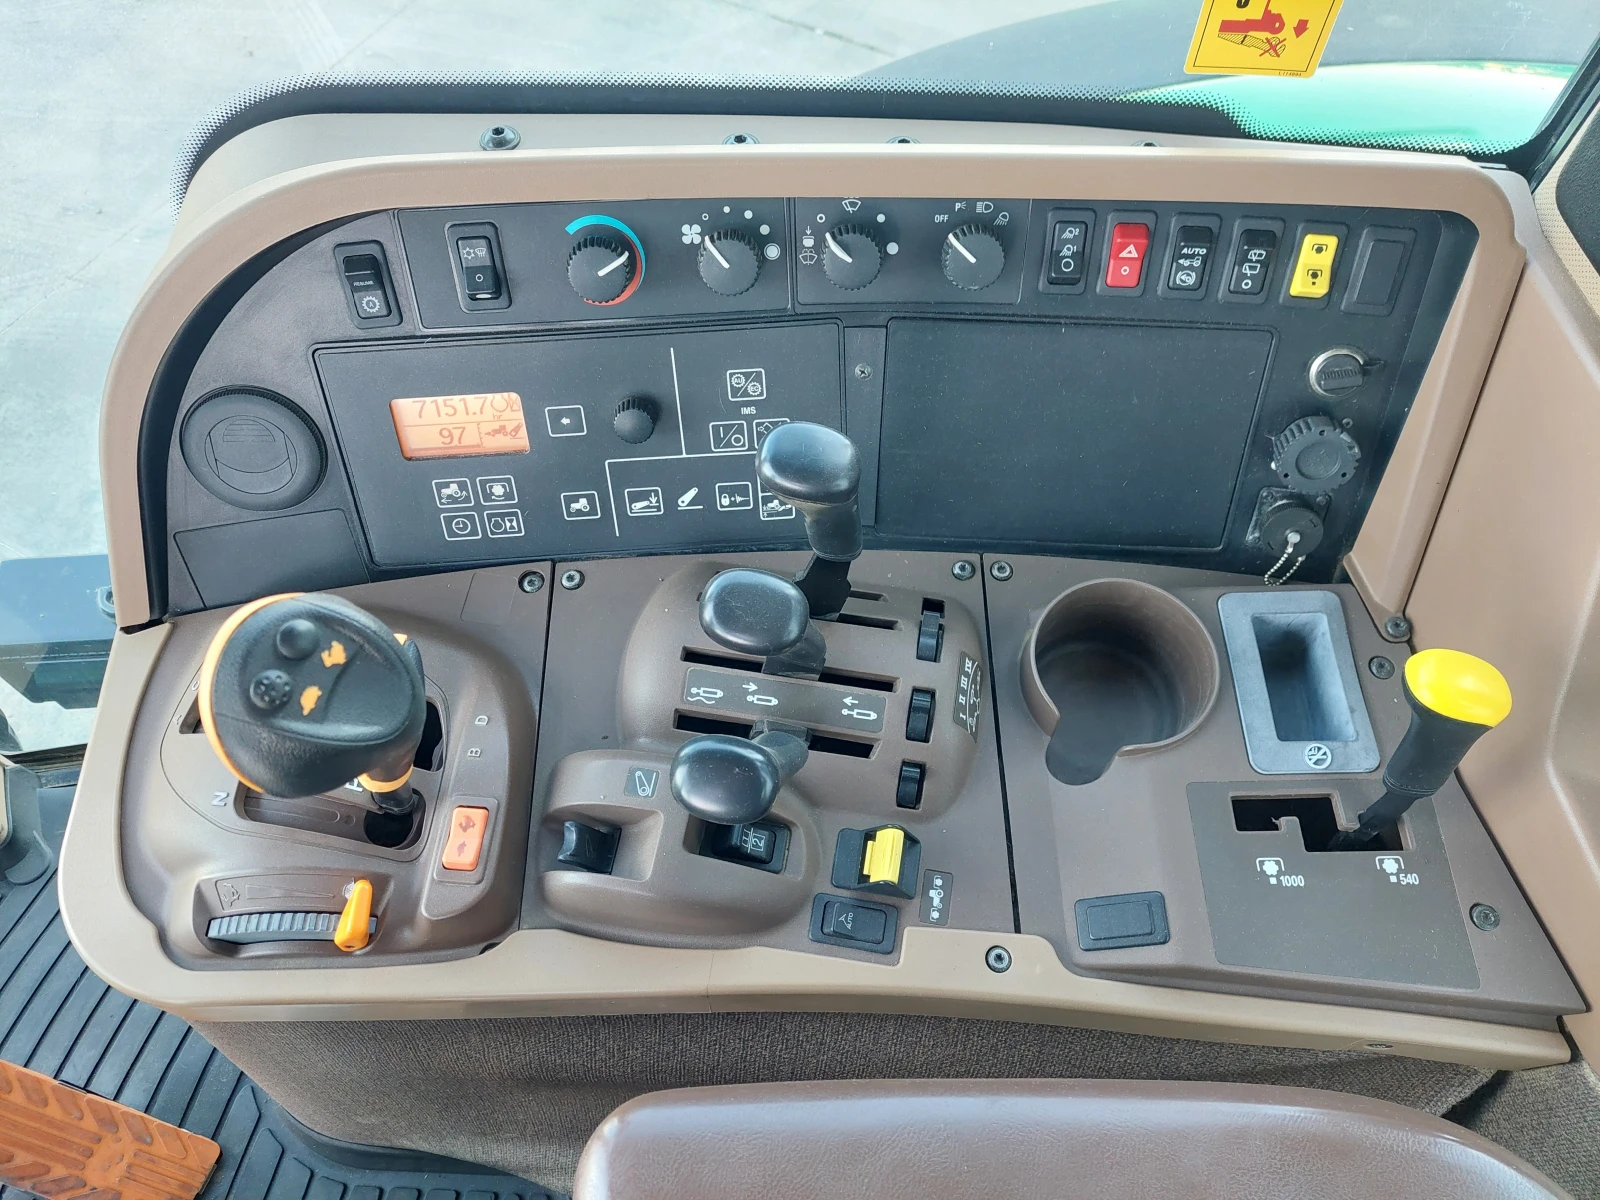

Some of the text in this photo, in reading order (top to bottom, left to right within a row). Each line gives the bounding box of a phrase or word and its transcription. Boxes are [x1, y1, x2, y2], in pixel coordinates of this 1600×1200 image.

[934, 214, 949, 224] OFF
[1181, 247, 1207, 256] AUTO
[412, 396, 489, 419] 7151.7
[740, 407, 757, 416] IMS
[439, 426, 467, 446] 97
[474, 715, 489, 726] D
[467, 747, 482, 758] B
[211, 791, 229, 806] N
[1279, 875, 1305, 887] 1000
[1399, 873, 1419, 885] 540
[846, 912, 854, 931] AUTO
